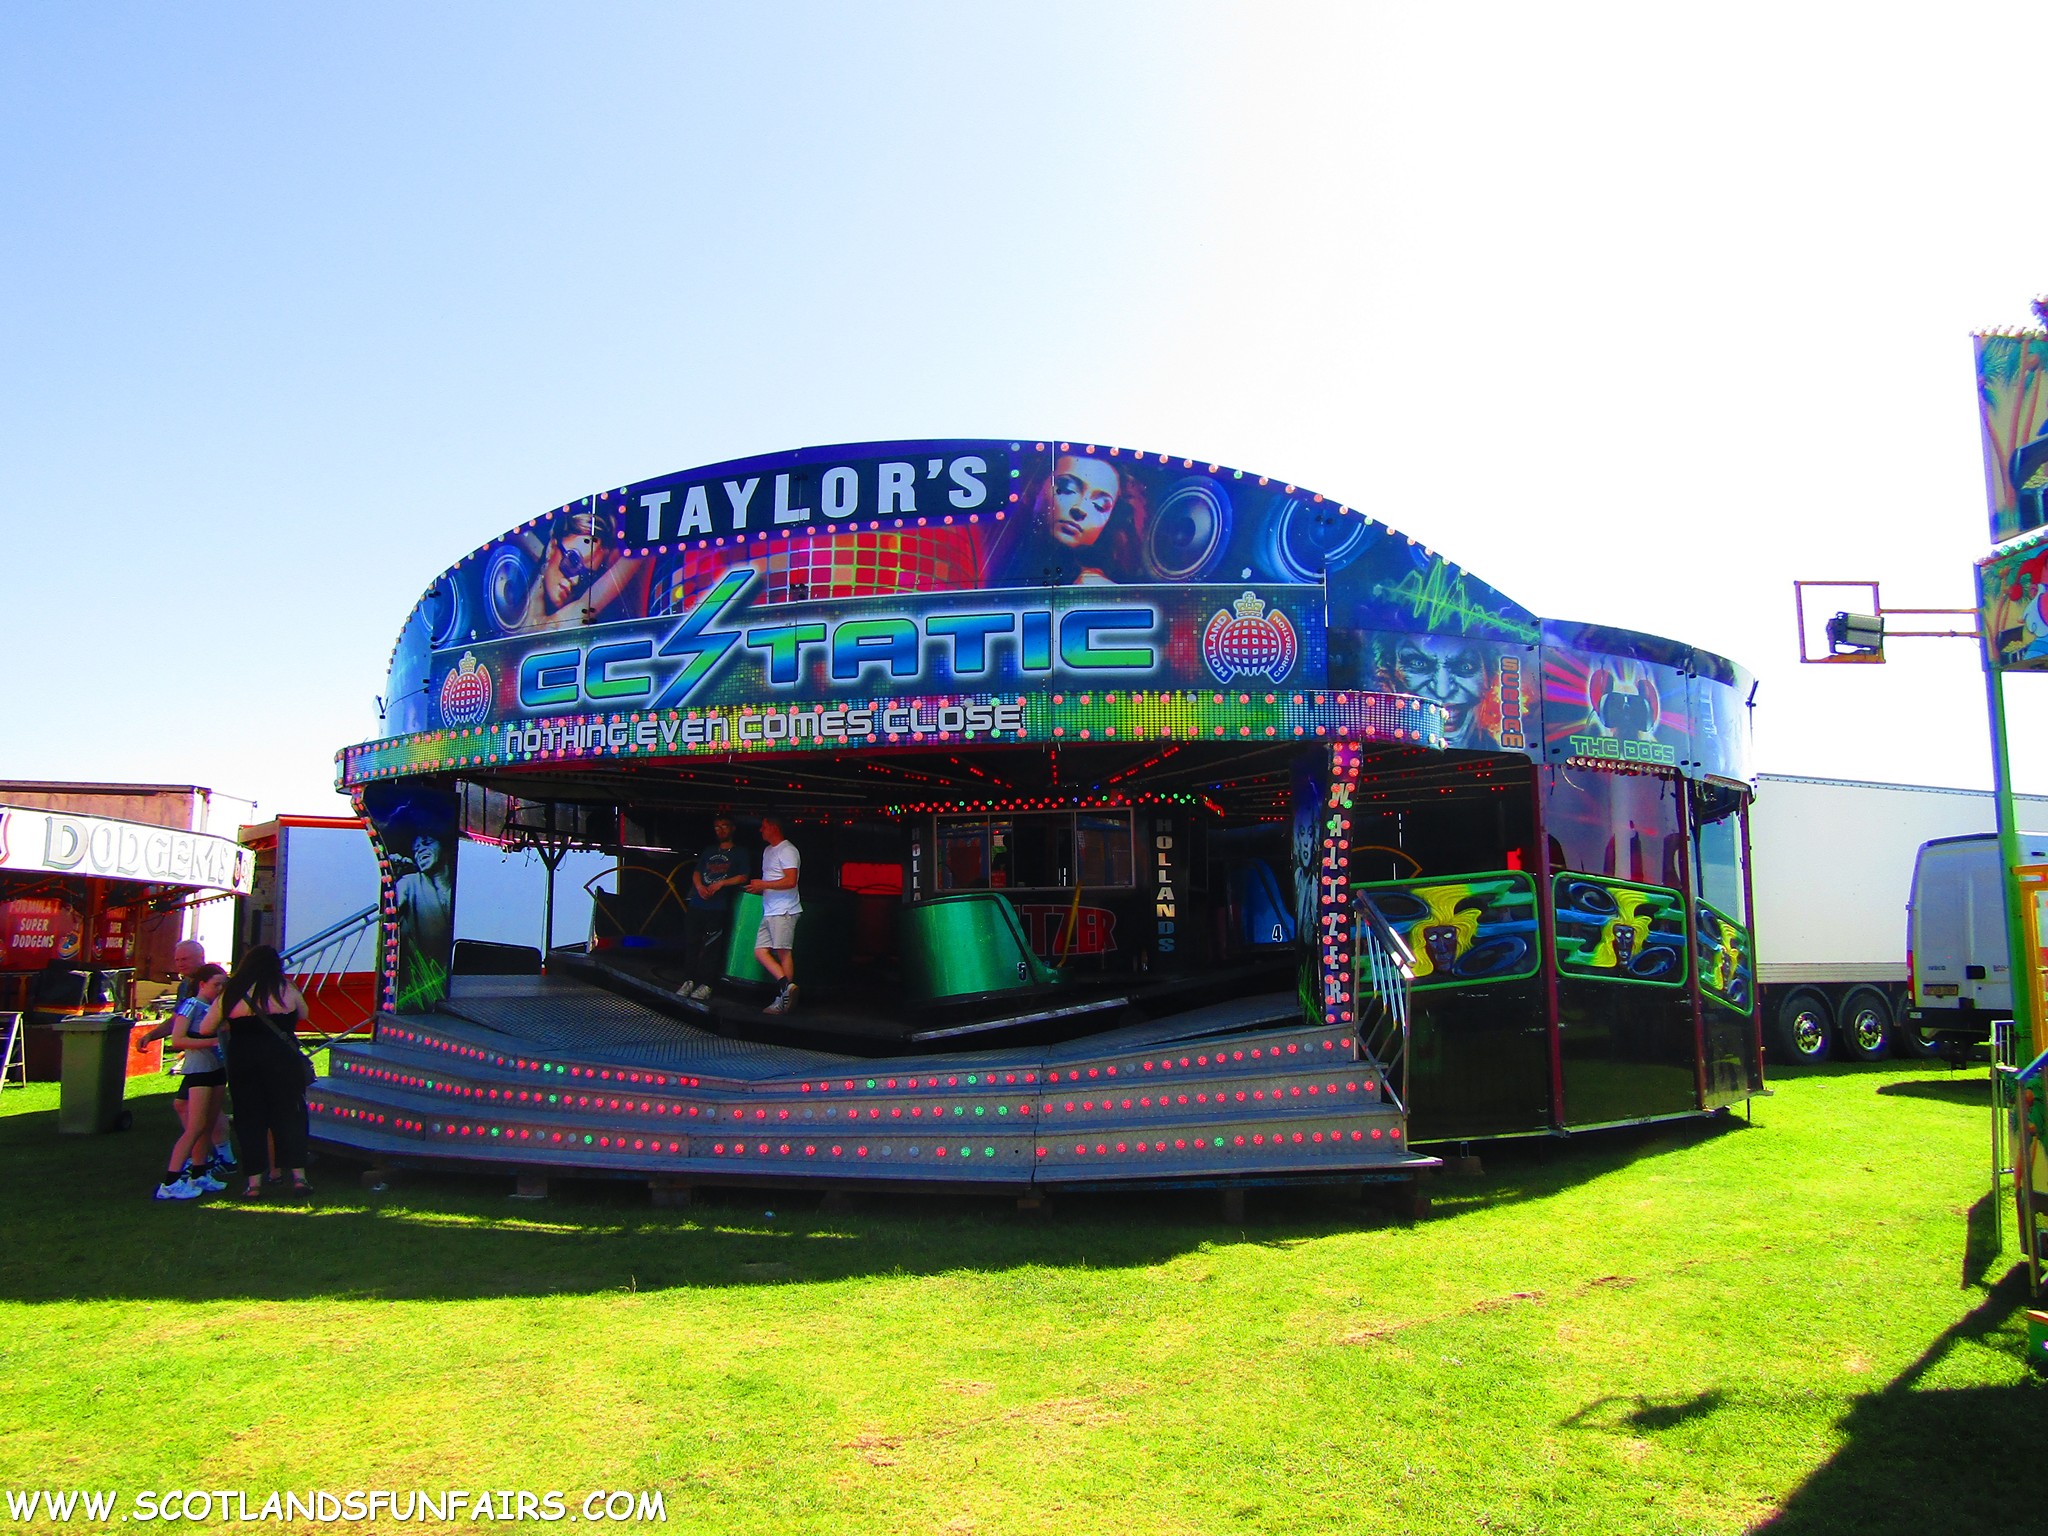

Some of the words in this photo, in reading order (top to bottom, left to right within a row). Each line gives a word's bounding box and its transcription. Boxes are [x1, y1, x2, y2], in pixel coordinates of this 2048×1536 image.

[641, 456, 989, 541] TAYLOR'S
[1208, 615, 1228, 678] HOLLAND
[1273, 615, 1292, 678] CORPORATION
[443, 674, 455, 726] HOLLAND
[506, 722, 628, 754] NOTHING
[636, 717, 729, 745] EVEN
[739, 710, 873, 740] COMES
[883, 705, 1021, 733] CLOSE
[1570, 735, 1619, 759] THE
[1623, 740, 1675, 764] DOGS
[42, 816, 229, 885] DODGEMS
[1156, 819, 1176, 952] HOLLANDS
[1328, 782, 1350, 1004] WALTZER
[12, 935, 55, 948] DODGEMS
[20, 918, 49, 931] SUPER
[1013, 903, 1118, 957] TZER
[1272, 924, 1283, 943] 4
